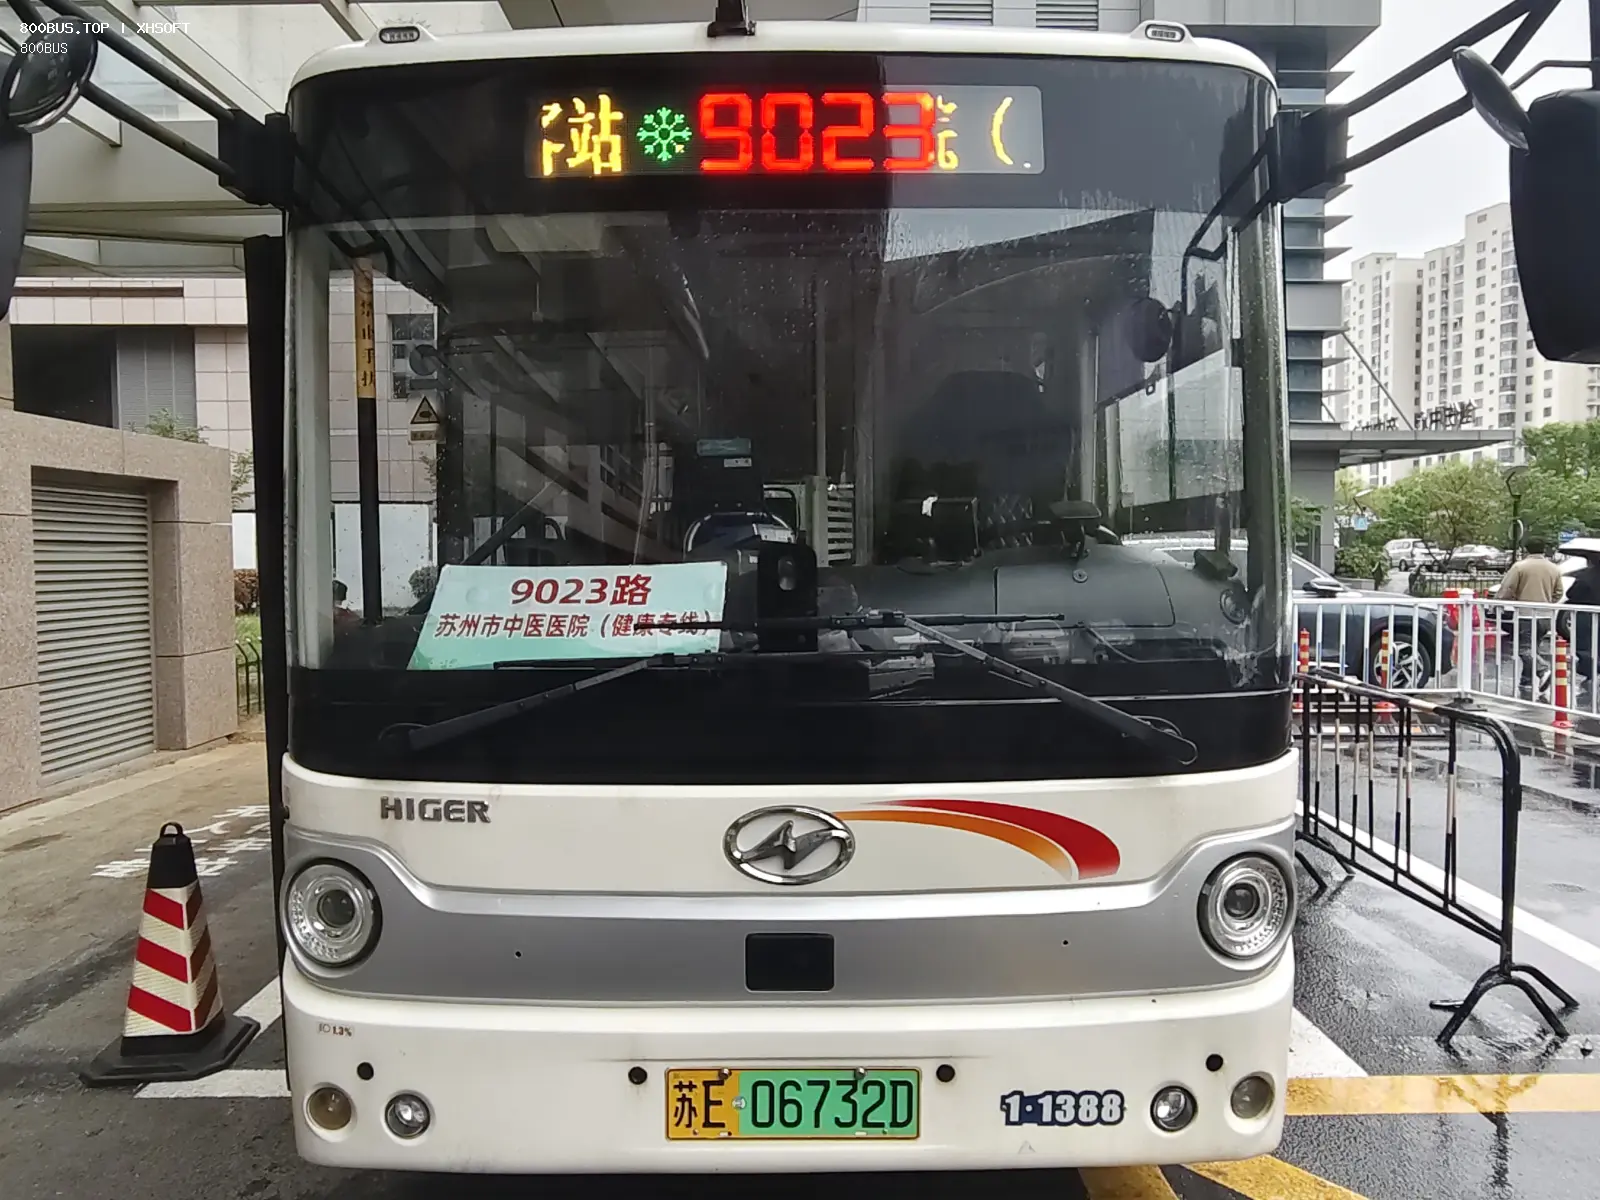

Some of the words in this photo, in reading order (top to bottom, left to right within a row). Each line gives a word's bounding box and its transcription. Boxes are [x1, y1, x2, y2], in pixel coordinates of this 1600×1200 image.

[699, 92, 936, 171] 9023
[510, 573, 652, 606] 9023路
[380, 796, 491, 823] HIGER
